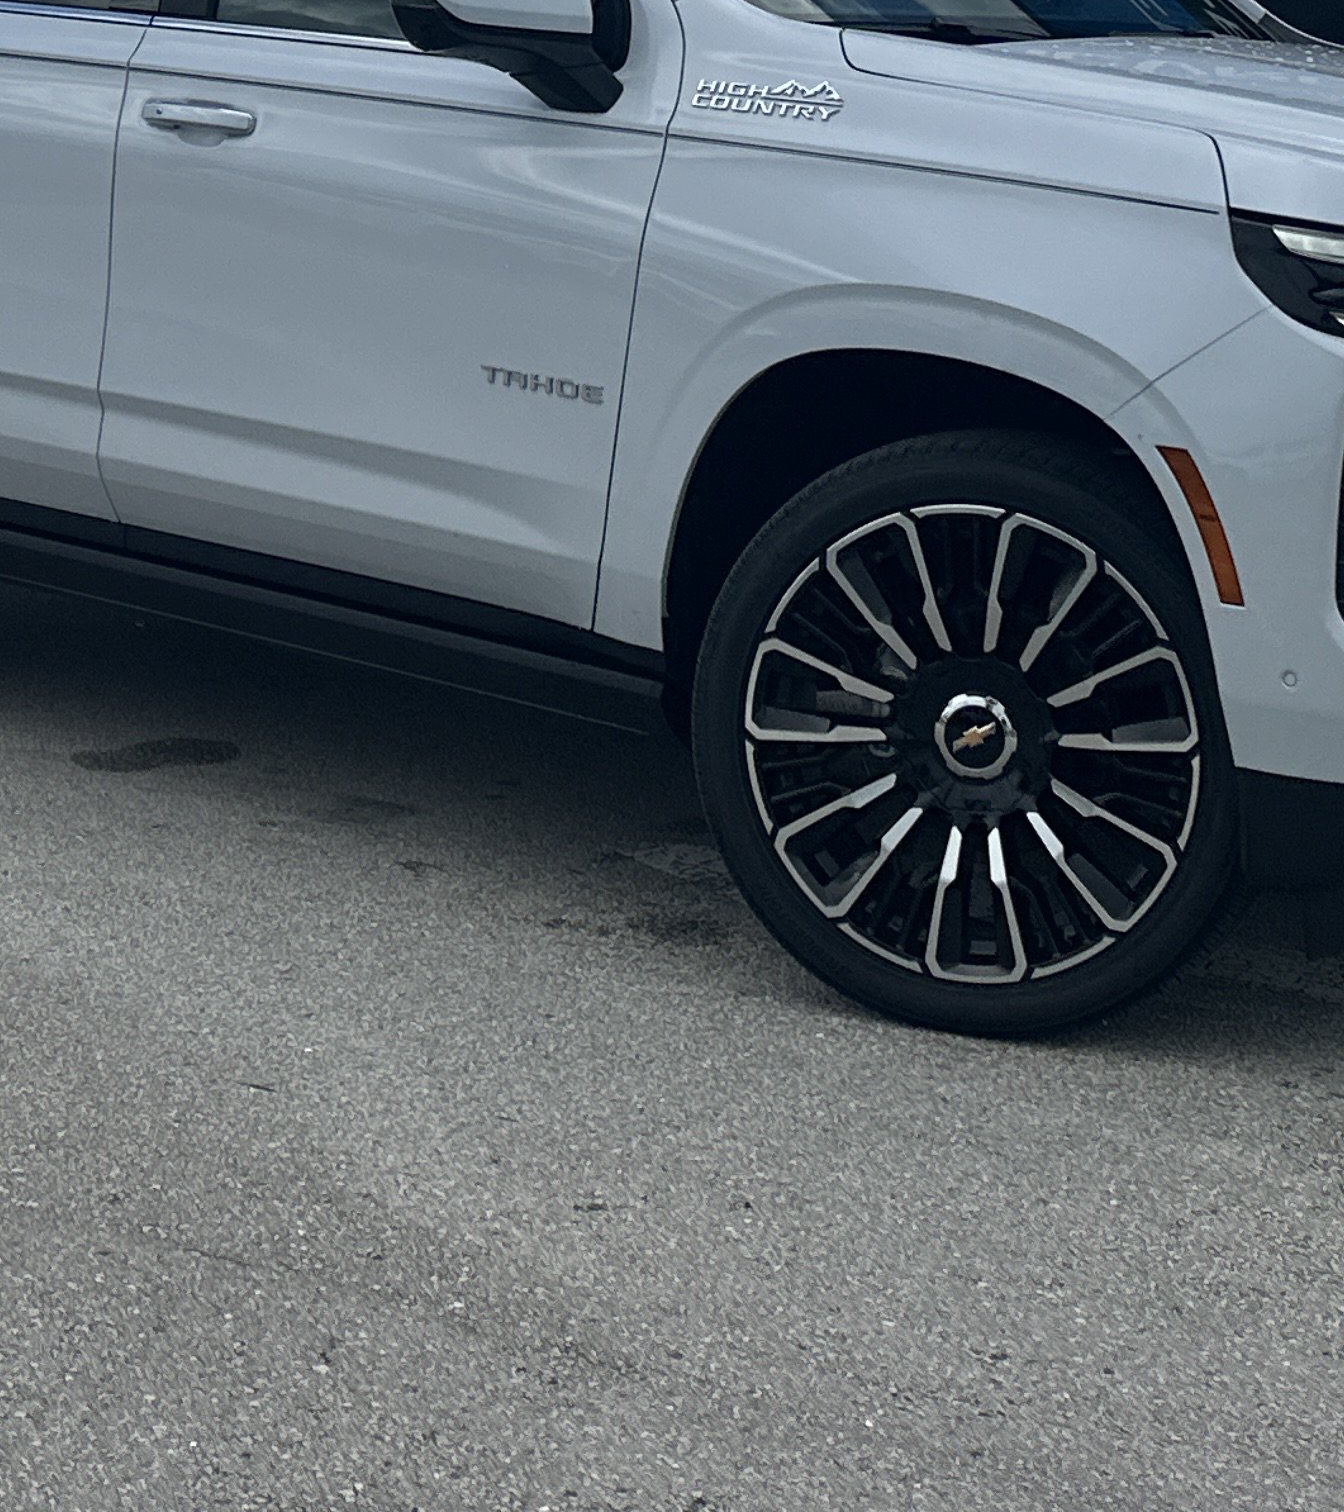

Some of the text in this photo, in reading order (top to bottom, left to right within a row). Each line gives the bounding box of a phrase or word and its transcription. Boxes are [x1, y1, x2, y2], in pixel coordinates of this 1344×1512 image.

[697, 78, 769, 97] HIGH
[692, 93, 841, 122] COUNTRY
[481, 365, 605, 405] TAHOE
